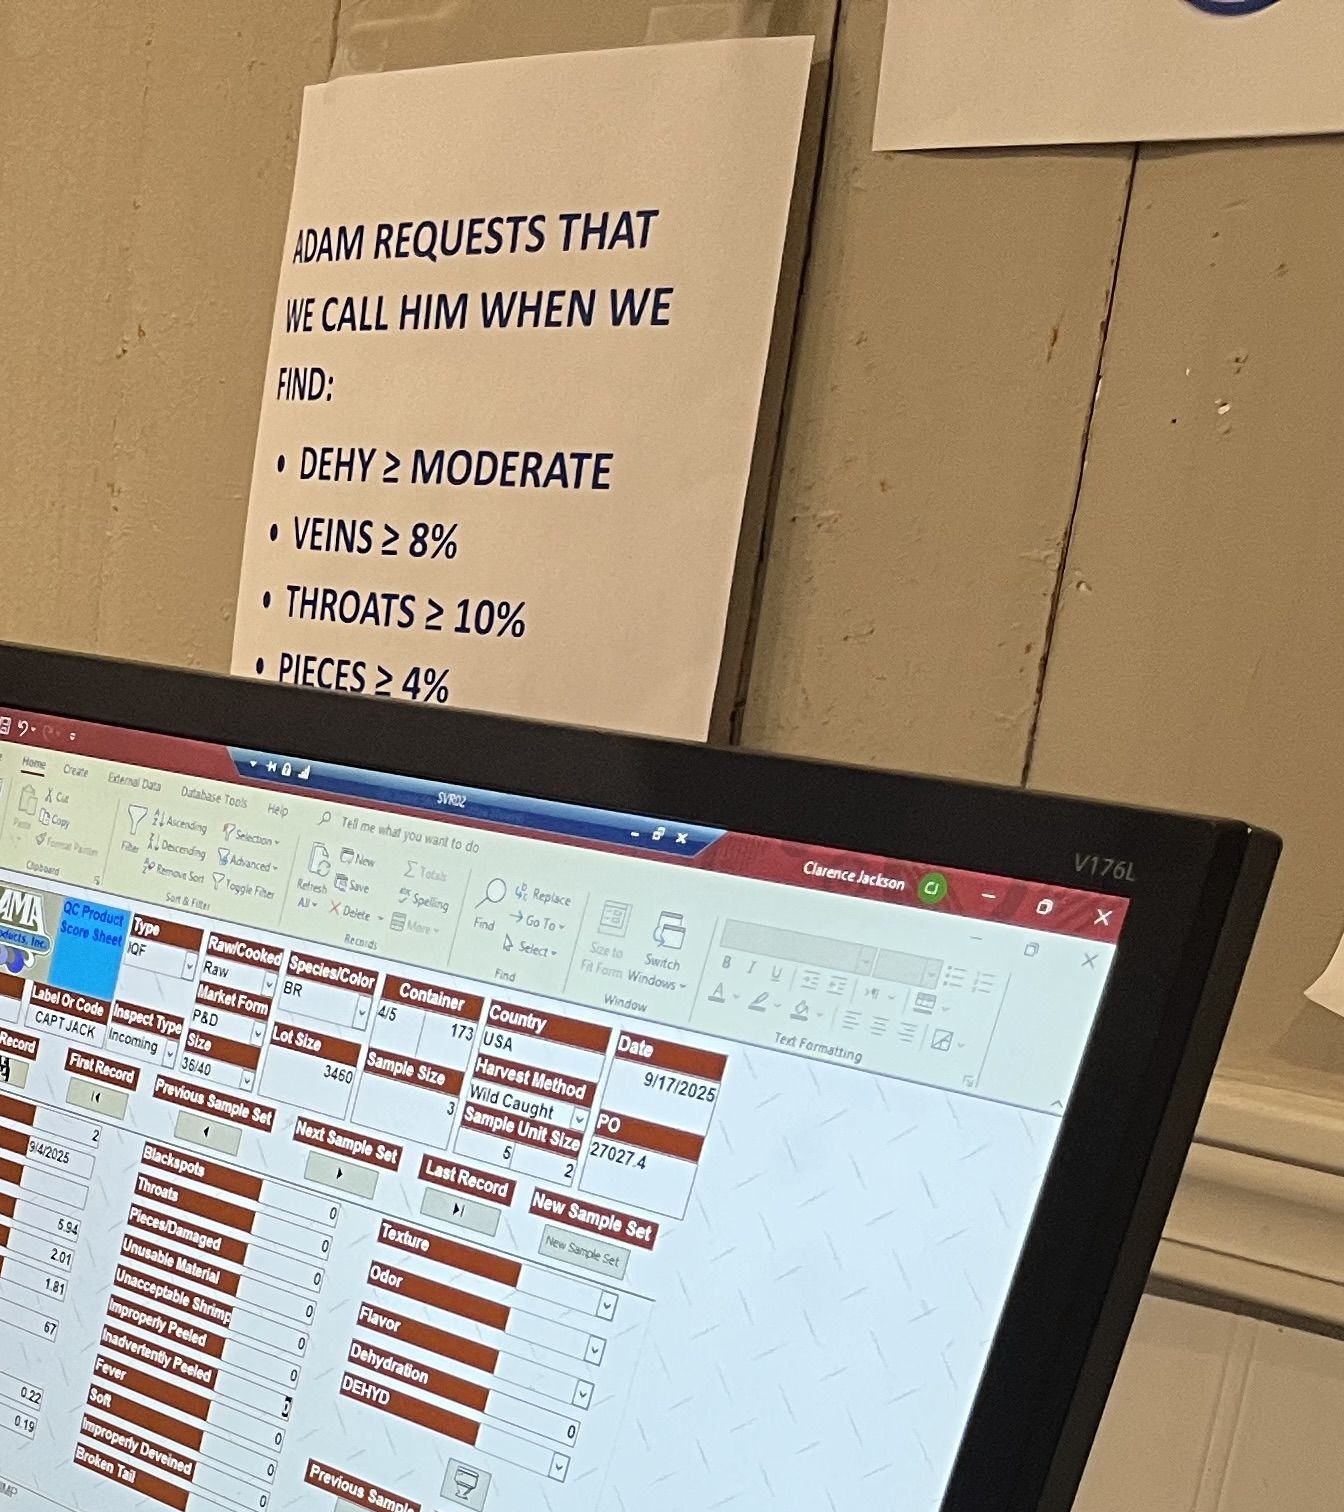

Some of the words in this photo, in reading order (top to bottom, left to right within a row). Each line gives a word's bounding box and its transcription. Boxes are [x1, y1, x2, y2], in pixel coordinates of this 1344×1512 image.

[293, 225, 365, 263] ADAM
[374, 215, 546, 263] REQUESTS
[559, 210, 659, 251] THAT
[286, 298, 314, 333] WE
[322, 296, 388, 332] CALL
[399, 293, 469, 329] HIM
[481, 290, 596, 329] WHEN
[610, 288, 673, 326] WE
[277, 367, 334, 401] FIND:
[300, 447, 377, 481] DEHY
[383, 451, 400, 484] ≥
[411, 449, 613, 490] MODERATE
[294, 516, 373, 554] VEINS
[382, 523, 400, 556] ≥
[409, 523, 458, 559] 8%
[286, 585, 415, 628] THROATS
[425, 599, 444, 631] ≥
[454, 599, 526, 637] 10%
[280, 653, 366, 694] PIECES
[375, 665, 393, 696] ≥
[402, 667, 450, 703] 4%
[22, 756, 47, 771] Home
[63, 763, 89, 779] Create
[52, 813, 70, 830] Copy
[803, 860, 854, 883] Clarence
[857, 870, 905, 892] Jackson
[1074, 853, 1137, 881] V176L
[63, 902, 80, 916] QC
[81, 905, 124, 928] Product
[134, 916, 160, 937] Type
[473, 916, 495, 931] Find
[60, 921, 90, 939] Score
[92, 927, 123, 948] Sheet
[209, 936, 282, 966] Raw/Cooked
[204, 960, 229, 978] Raw
[289, 954, 375, 990] Species/Color
[32, 985, 59, 1005] Label
[60, 993, 74, 1009] Or
[74, 995, 104, 1016] Code
[197, 984, 235, 1007] Market
[236, 996, 268, 1015] Form
[283, 981, 303, 997] BR
[399, 982, 465, 1012] Container
[35, 1011, 64, 1030] CAPT
[65, 1018, 96, 1039] JACK
[113, 1003, 153, 1027] Inspect
[155, 1013, 182, 1034] Type
[192, 1009, 218, 1027] P&D
[377, 1006, 397, 1022] 4/5
[450, 1023, 475, 1041] 173
[489, 1005, 547, 1033] Country
[109, 1028, 158, 1055] Incoming
[187, 1033, 212, 1052] Size
[272, 1027, 293, 1046] Lot
[295, 1032, 322, 1053] Size
[483, 1031, 513, 1052] USA
[618, 1036, 654, 1058] Date
[775, 1031, 797, 1048] Text
[798, 1037, 863, 1064] Formatting
[181, 1057, 211, 1077] 36/40
[323, 1065, 353, 1085] 3460
[367, 1051, 414, 1078] Sample
[416, 1063, 447, 1086] Size
[475, 1058, 530, 1087] Harvest
[532, 1072, 587, 1100] Method
[643, 1072, 717, 1103] 9/17/2025
[470, 1084, 500, 1105] Wild
[502, 1093, 554, 1121] Caught
[464, 1106, 514, 1135] Sample
[517, 1121, 546, 1140] Unit
[547, 1130, 580, 1153] Size
[597, 1115, 622, 1132] PO
[29, 1140, 70, 1164] 9/4/2025
[296, 1121, 325, 1143] Next
[327, 1130, 373, 1159] Sample
[375, 1146, 398, 1164] Set
[590, 1141, 647, 1170] 27027.4
[144, 1145, 205, 1178] Blackspots
[138, 1175, 179, 1202] Throats
[425, 1160, 456, 1183] Last
[457, 1170, 508, 1197] Record
[57, 1218, 78, 1235] 5.94
[129, 1208, 222, 1252] Pieces/Damaged
[532, 1193, 566, 1217] New
[568, 1203, 621, 1232] Sample
[625, 1221, 652, 1242] Set
[381, 1223, 430, 1252] Texture
[50, 1248, 71, 1266] 2.01
[123, 1239, 175, 1270] Unusable
[177, 1256, 221, 1283] Material
[45, 1278, 65, 1295] 1.81
[370, 1265, 403, 1288] Odor
[359, 1306, 401, 1333] Flavor
[350, 1343, 429, 1384] Dehydration
[342, 1375, 391, 1405] DEHYD
